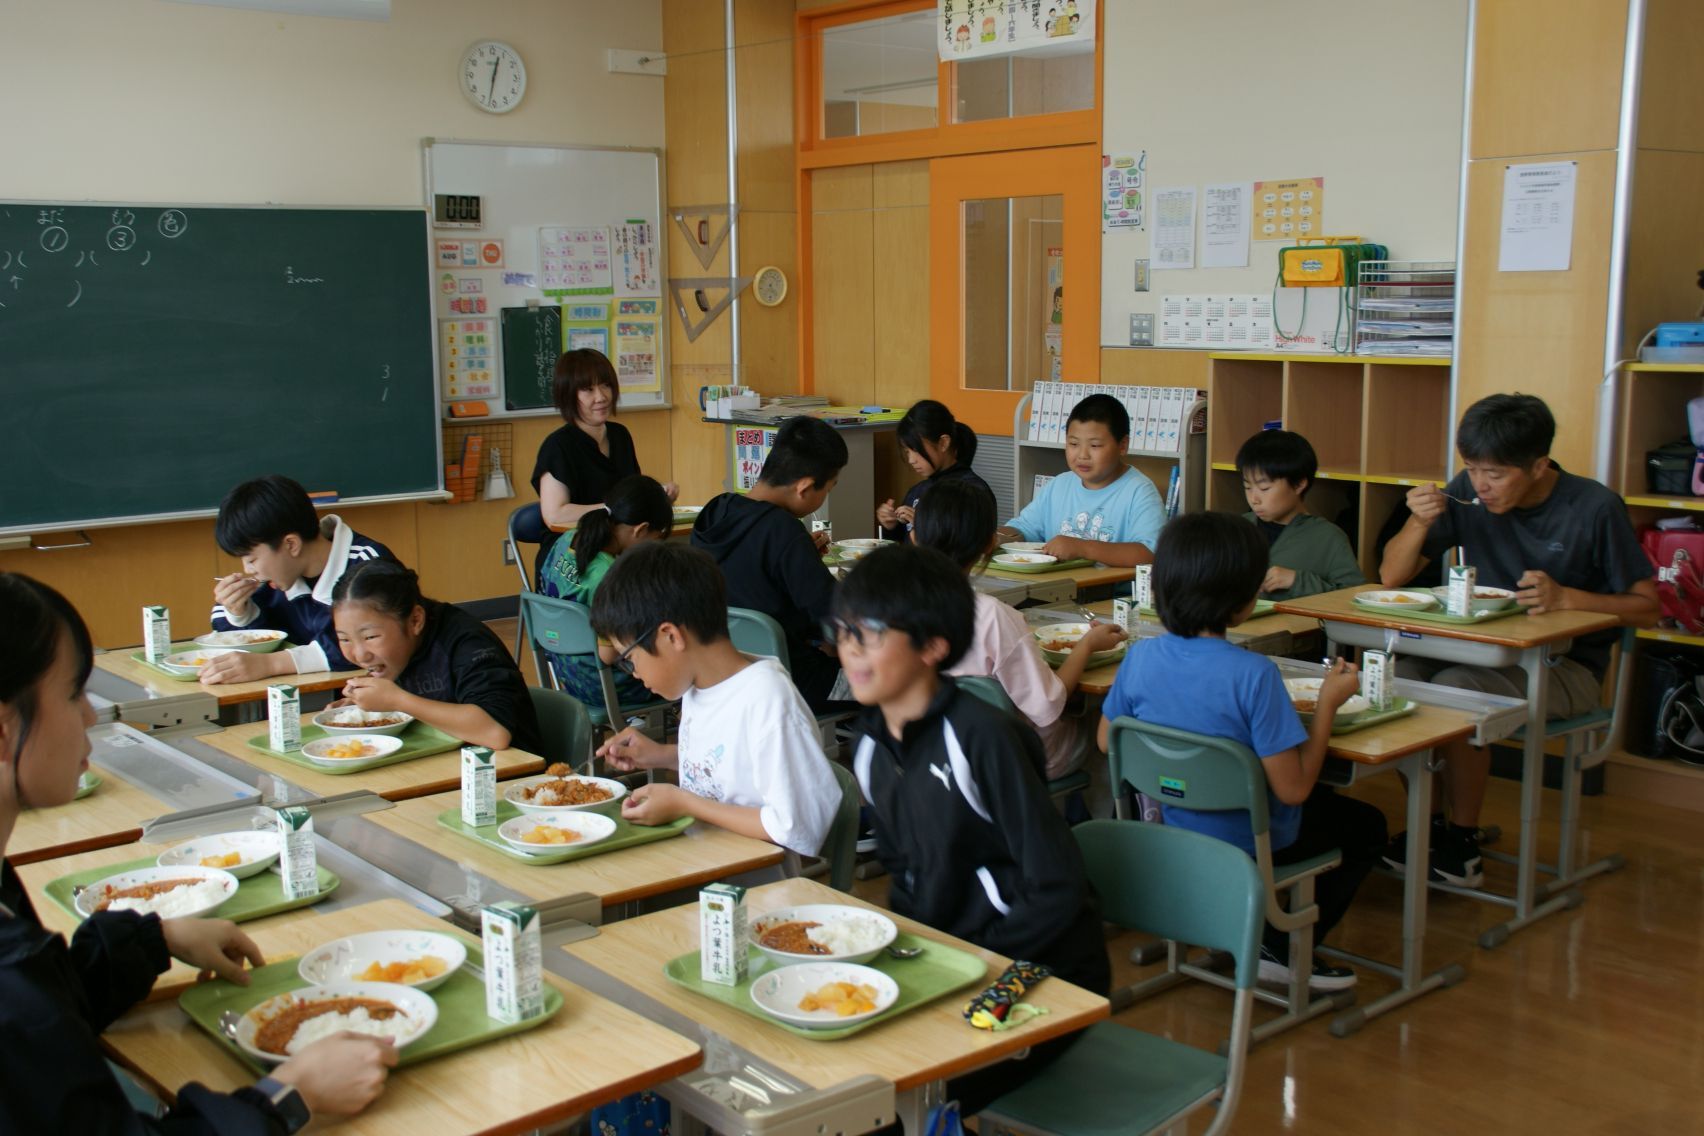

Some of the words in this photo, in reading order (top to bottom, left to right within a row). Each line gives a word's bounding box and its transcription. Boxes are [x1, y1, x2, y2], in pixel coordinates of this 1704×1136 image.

[37, 208, 65, 225] まだ
[111, 208, 136, 226] もう
[739, 431, 761, 446] まとめ
[712, 914, 724, 975] よつ葉牛乳
